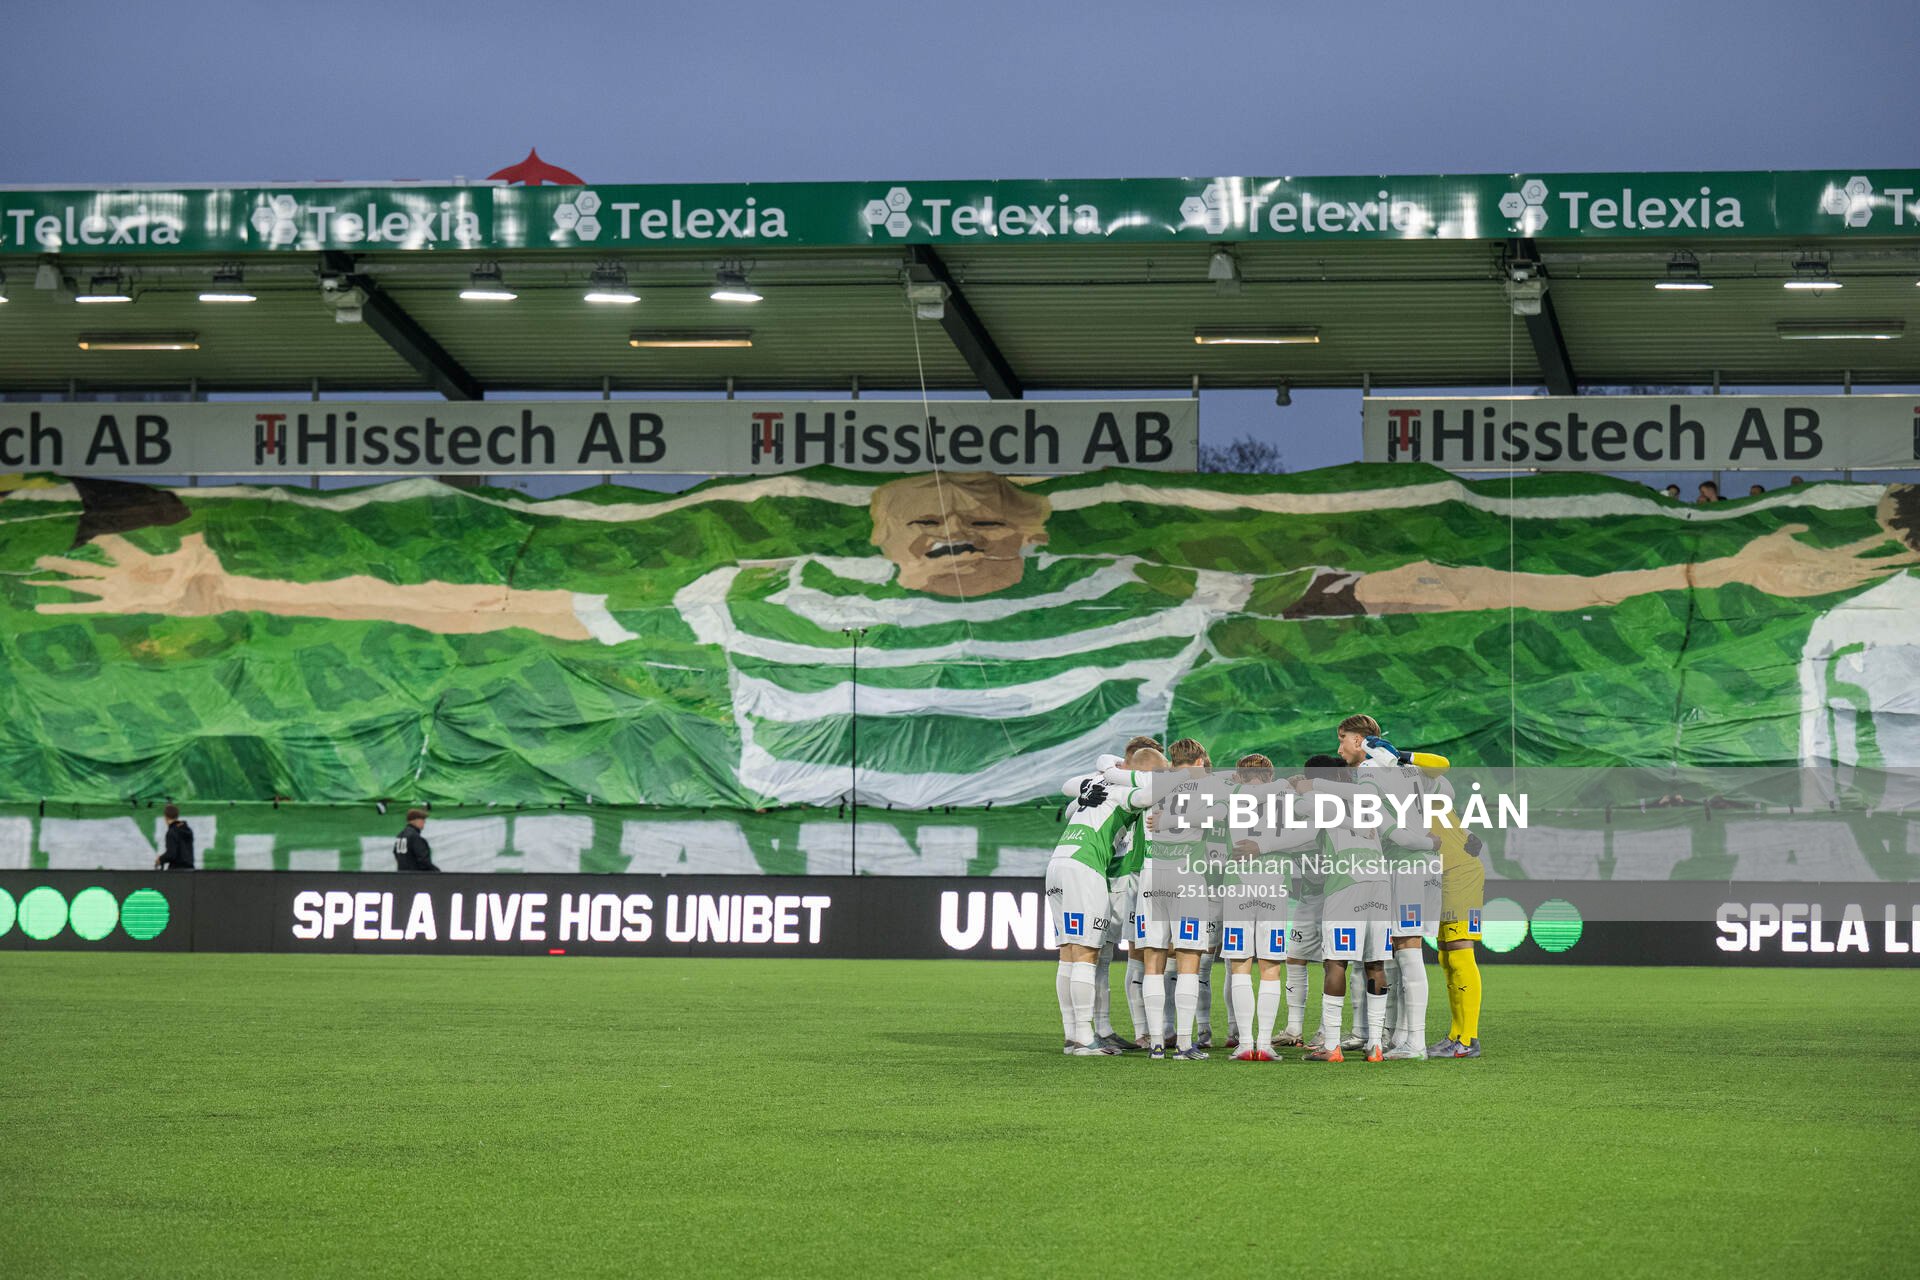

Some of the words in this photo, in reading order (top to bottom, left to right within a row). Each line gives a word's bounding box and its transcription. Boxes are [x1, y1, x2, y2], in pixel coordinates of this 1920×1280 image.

[7, 205, 180, 246] Telexia
[308, 202, 482, 243] Telexia
[611, 197, 788, 240] Telexia
[923, 193, 1101, 237] Telexia
[1237, 190, 1421, 234] Telexia
[1559, 186, 1744, 229] Telexia
[85, 414, 172, 466] AB
[297, 410, 555, 466] Hisstech
[577, 411, 666, 464] AB
[794, 409, 1060, 465] Hisstech
[1082, 411, 1186, 464] AB
[1432, 404, 1705, 462] Hisstech
[1729, 407, 1824, 461] AB
[292, 891, 437, 941] SPELA
[449, 892, 548, 941] LIVE
[559, 893, 654, 942] HOS
[665, 894, 831, 944] UNIBET
[1715, 903, 1870, 953] SPELA
[1884, 904, 1920, 953] LI
